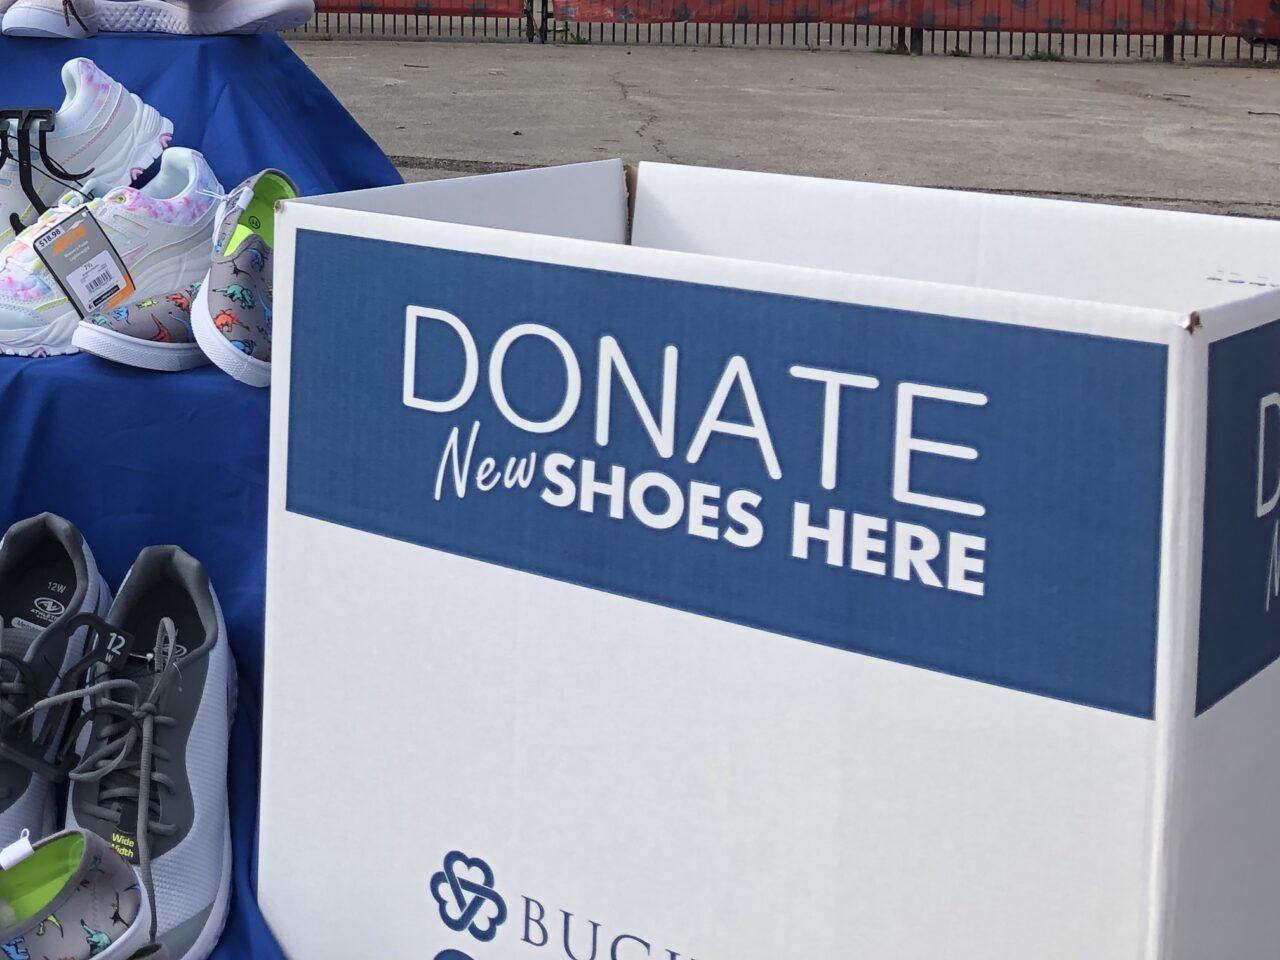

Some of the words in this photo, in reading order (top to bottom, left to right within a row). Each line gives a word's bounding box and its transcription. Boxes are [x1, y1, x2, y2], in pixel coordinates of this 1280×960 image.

[39, 228, 61, 247] $18.98
[402, 305, 989, 517] DONATE
[434, 420, 536, 501] New
[540, 452, 764, 548] SHOES
[791, 500, 987, 597] HERE
[47, 581, 67, 594] 12W
[107, 632, 126, 656] 12
[104, 652, 114, 664] W
[112, 832, 135, 847] Wide
